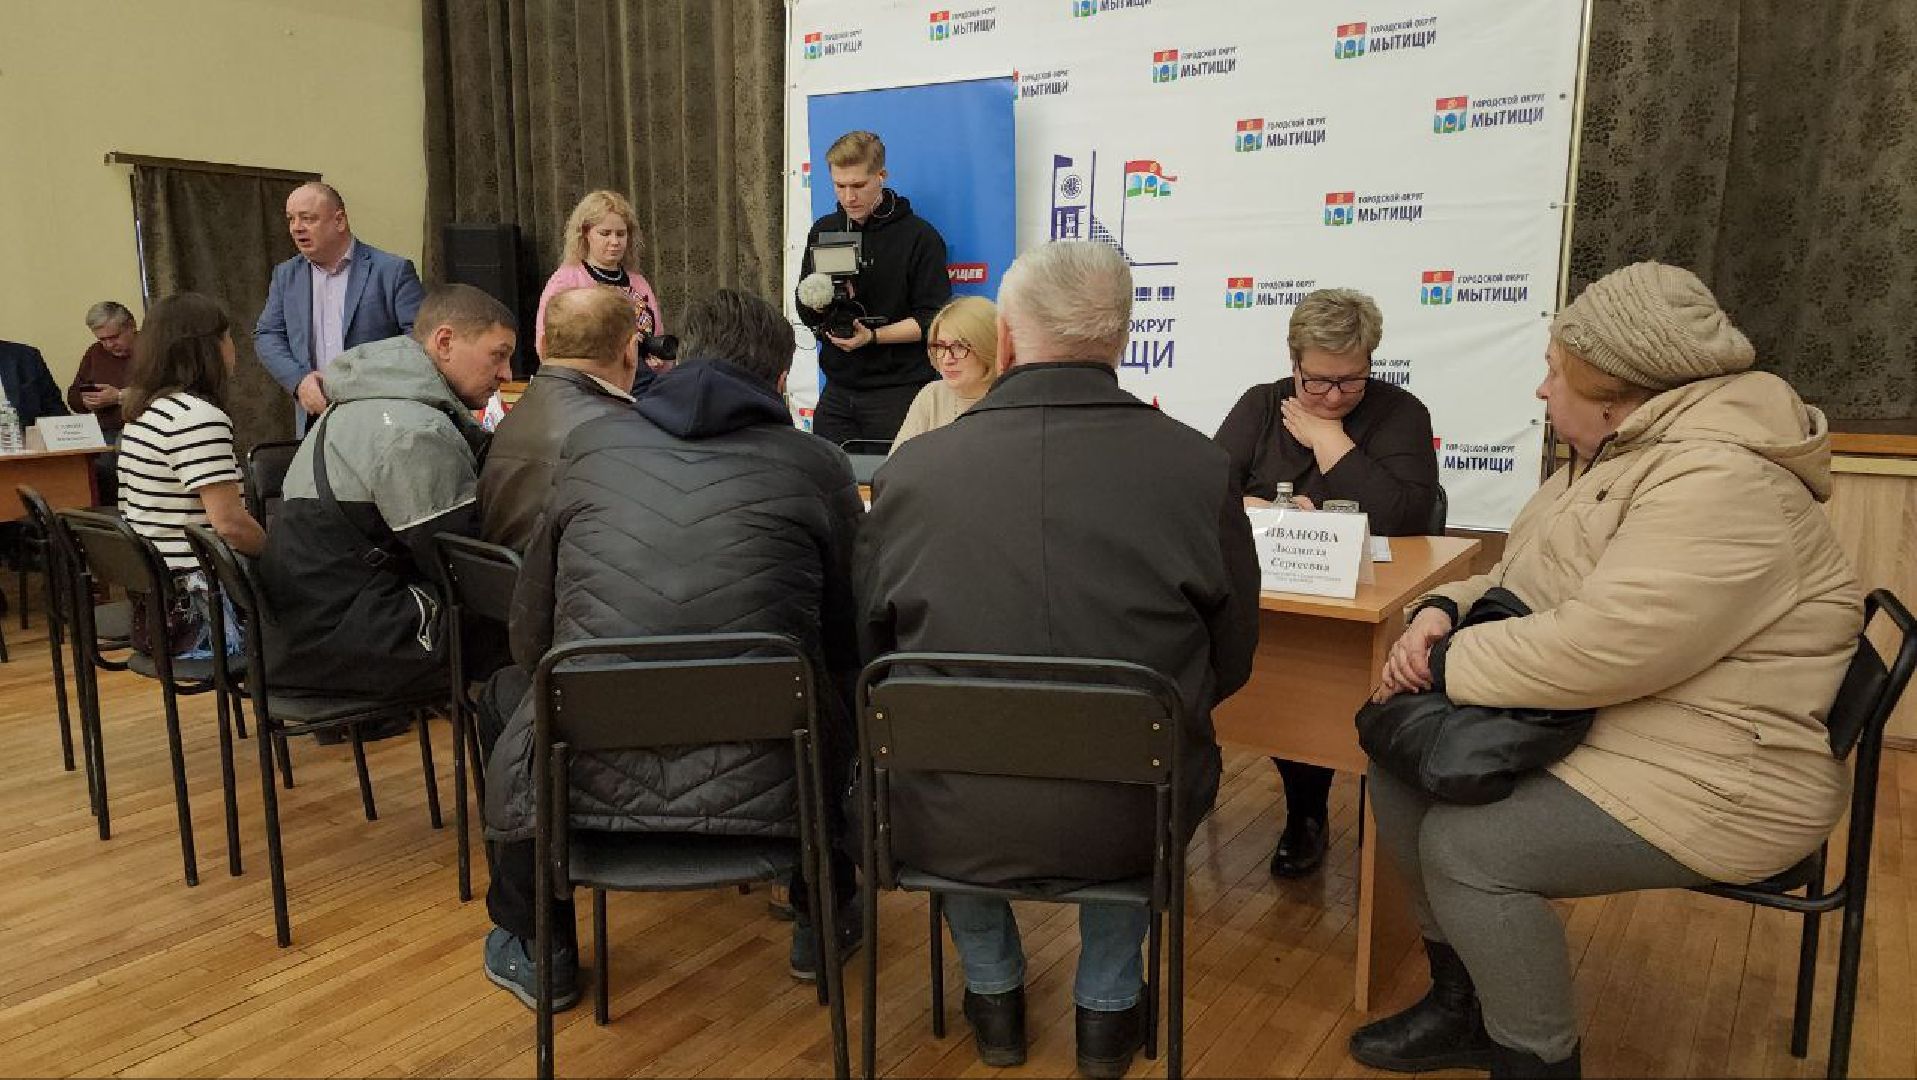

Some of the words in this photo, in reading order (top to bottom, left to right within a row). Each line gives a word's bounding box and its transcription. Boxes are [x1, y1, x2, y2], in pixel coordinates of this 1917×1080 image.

[952, 19, 996, 35] МЫТИЩИ
[824, 40, 863, 55] МЫТИЩИ
[1370, 30, 1437, 52] МЫТИЩИ
[1181, 59, 1236, 77] МЫТИЩИ
[1022, 80, 1068, 98] МЫТИЩИ
[1471, 107, 1545, 128] МЫТИЩИ
[1266, 130, 1326, 147] МЫТИЩИ
[1358, 205, 1422, 222] МЫТИЩИ
[1456, 286, 1528, 304] МЫТИЩИ
[1444, 455, 1514, 474] МЫТИЩИ
